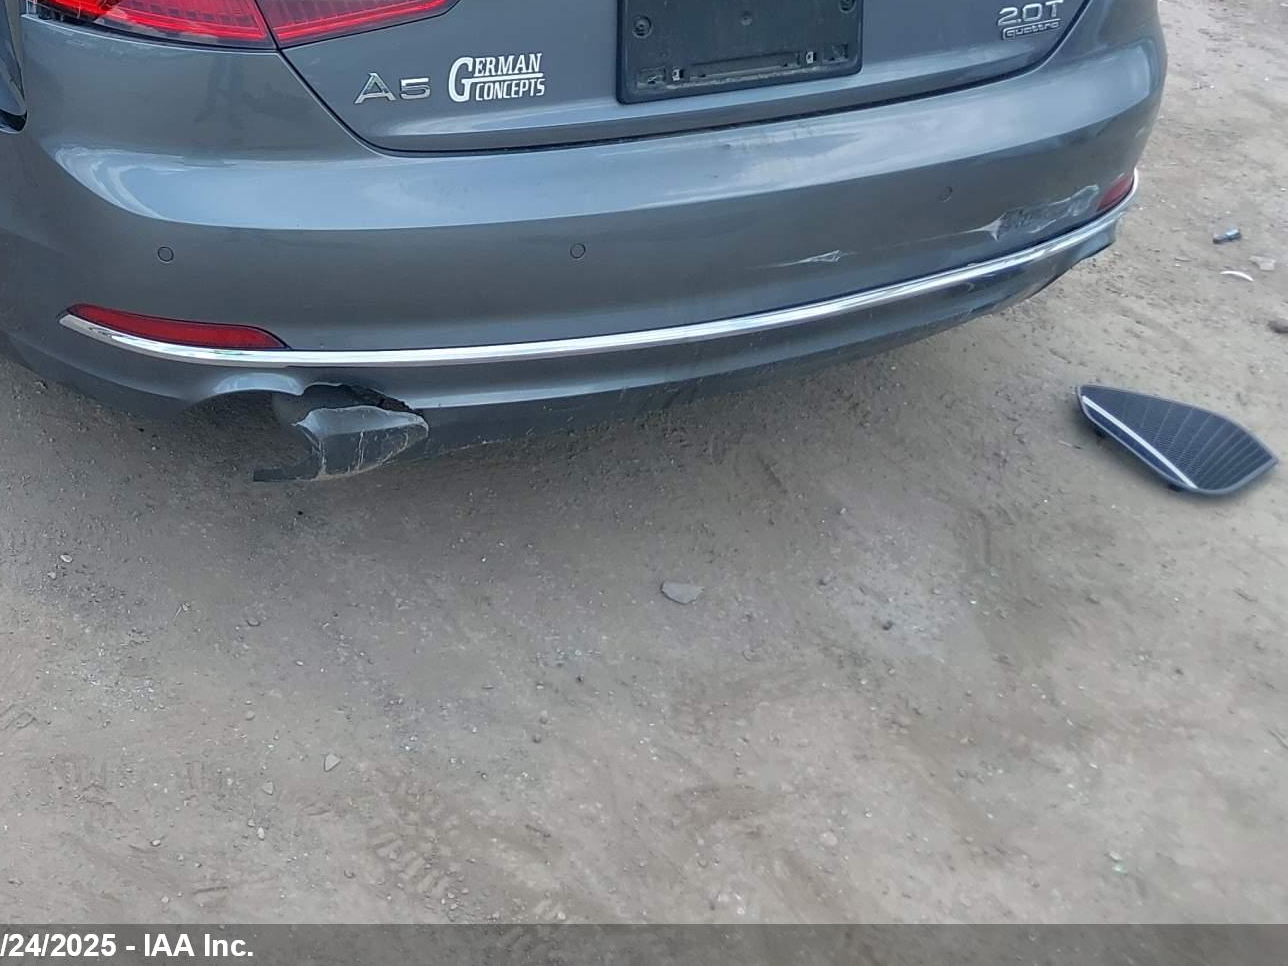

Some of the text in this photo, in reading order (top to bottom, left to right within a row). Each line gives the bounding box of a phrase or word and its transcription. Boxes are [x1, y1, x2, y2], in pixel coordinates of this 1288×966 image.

[353, 72, 432, 105] A5
[448, 52, 544, 103] GERMAN
[475, 78, 546, 102] CONCEPTS
